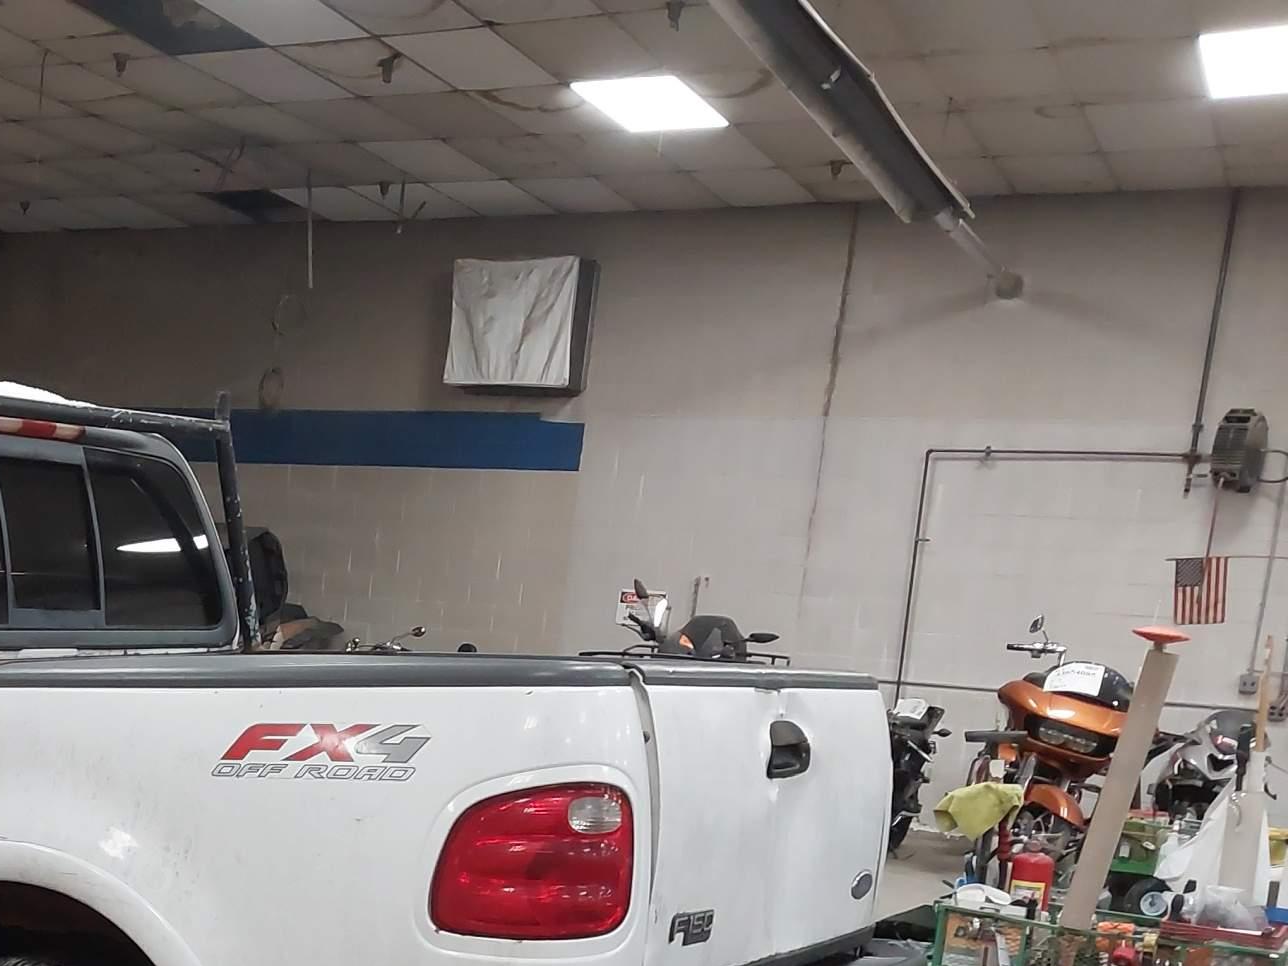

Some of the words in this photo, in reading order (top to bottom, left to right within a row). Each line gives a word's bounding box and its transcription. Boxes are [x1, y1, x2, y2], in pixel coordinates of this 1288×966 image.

[220, 723, 432, 763] FX4
[211, 762, 289, 778] OFF
[295, 763, 416, 781] ROAD
